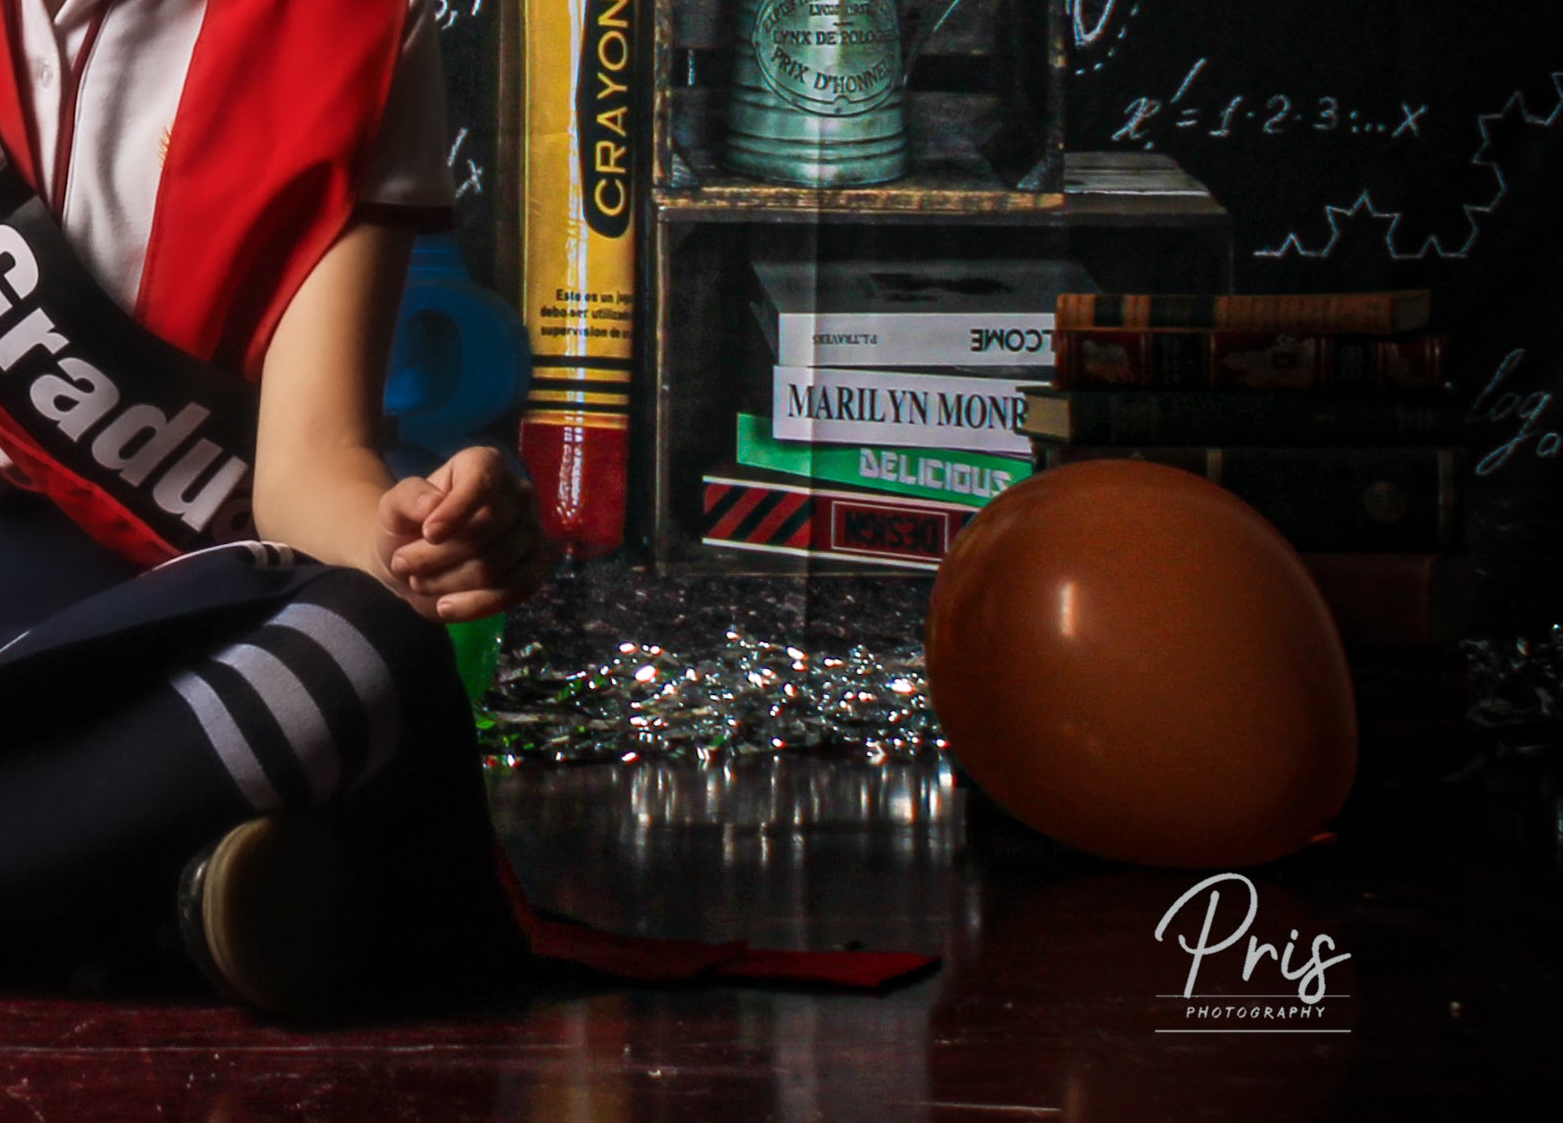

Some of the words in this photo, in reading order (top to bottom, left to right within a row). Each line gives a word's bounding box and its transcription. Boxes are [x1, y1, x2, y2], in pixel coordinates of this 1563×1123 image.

[772, 30, 813, 46] LYNX
[815, 30, 837, 46] DE
[770, 45, 809, 84] PRIX
[813, 60, 888, 94] D'HONNE
[788, 383, 930, 426] MARILYN
[858, 447, 1013, 498] DELICIOUS
